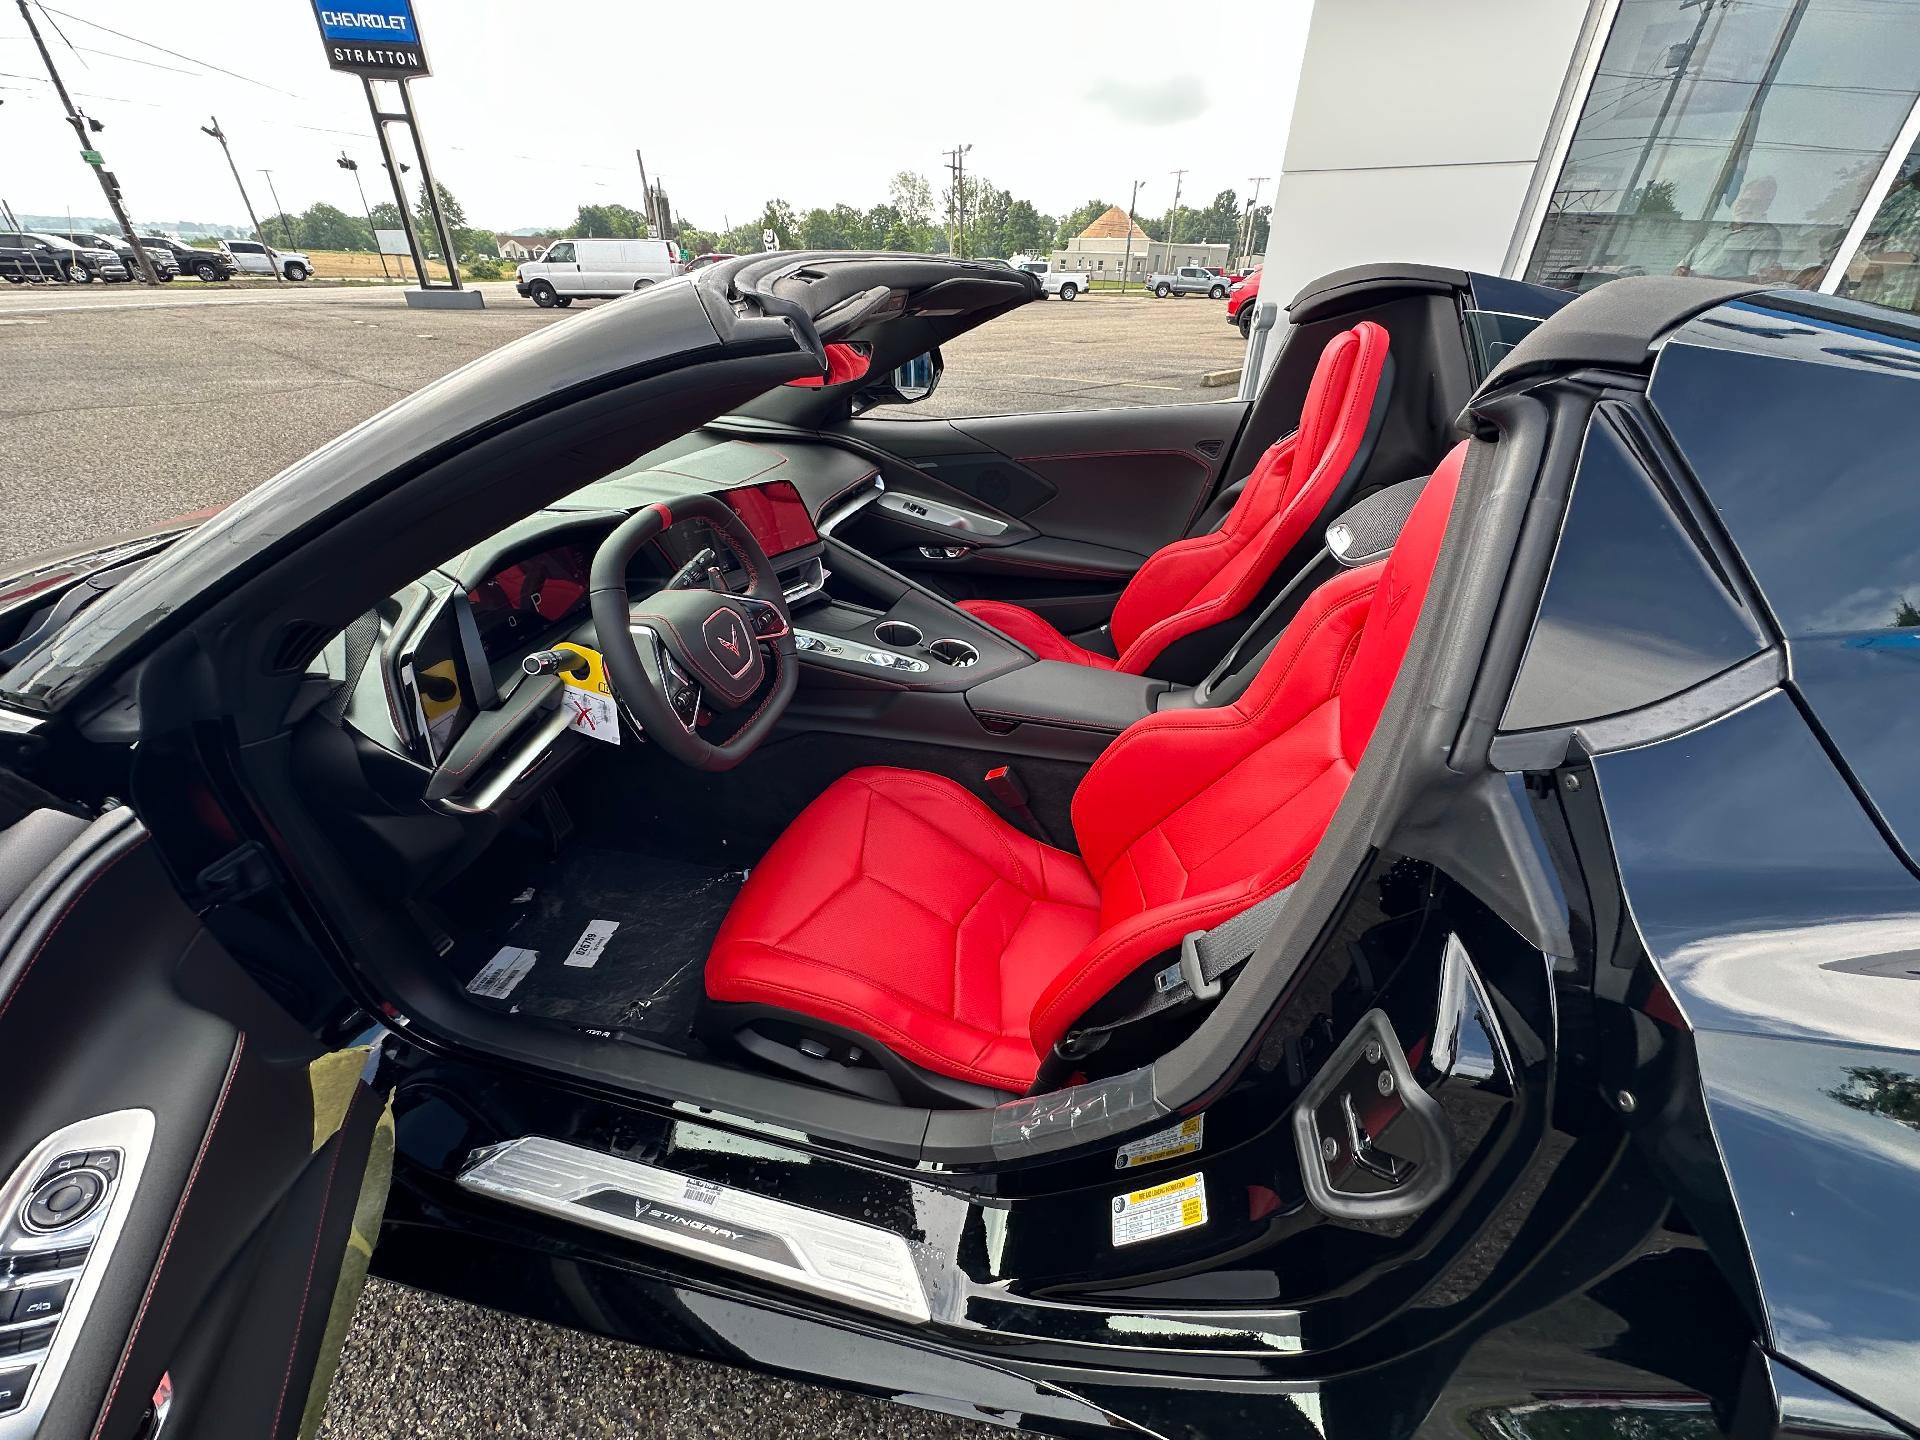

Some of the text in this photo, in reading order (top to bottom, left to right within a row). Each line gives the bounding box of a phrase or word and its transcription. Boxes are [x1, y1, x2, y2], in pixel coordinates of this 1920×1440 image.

[321, 11, 406, 30] CHEVROLET
[334, 47, 418, 66] STRATTON
[530, 592, 542, 613] P
[648, 1209, 744, 1240] STINGRAY
